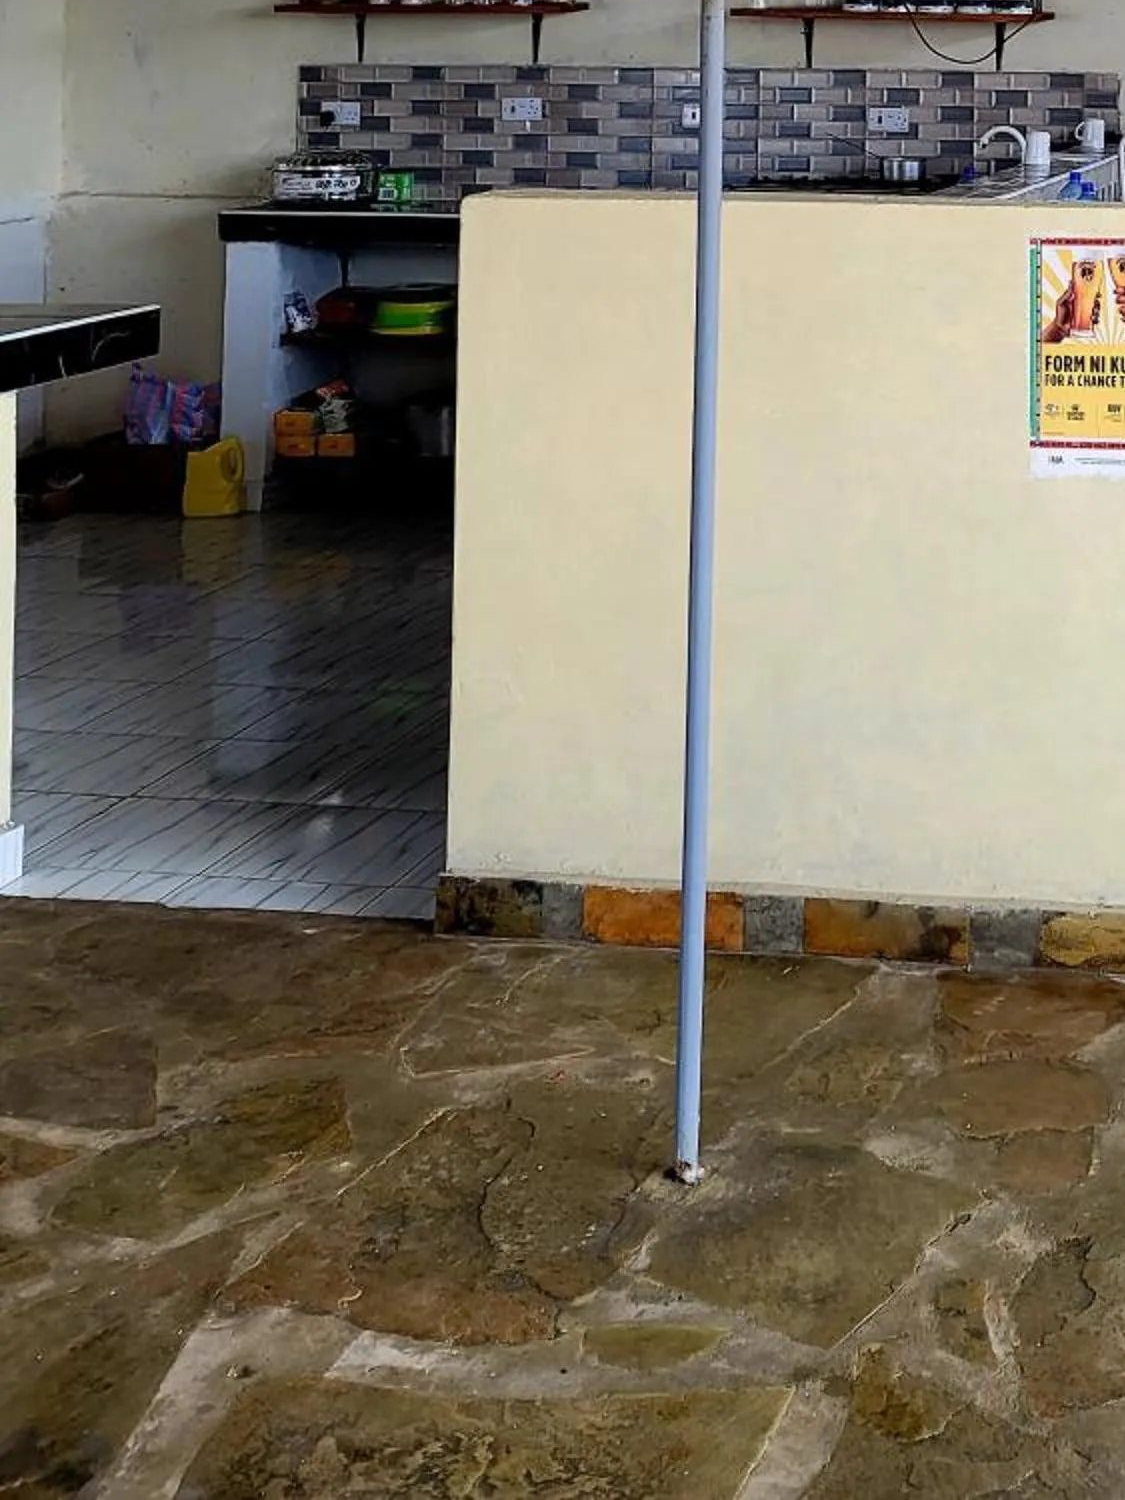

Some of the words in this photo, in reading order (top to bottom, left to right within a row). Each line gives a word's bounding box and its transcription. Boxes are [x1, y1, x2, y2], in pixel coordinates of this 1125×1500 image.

[1045, 355, 1085, 373] FORM
[1090, 355, 1105, 373] NI
[1044, 373, 1065, 387] FOR
[1067, 374, 1075, 387] A
[1077, 374, 1117, 388] CHANCE
